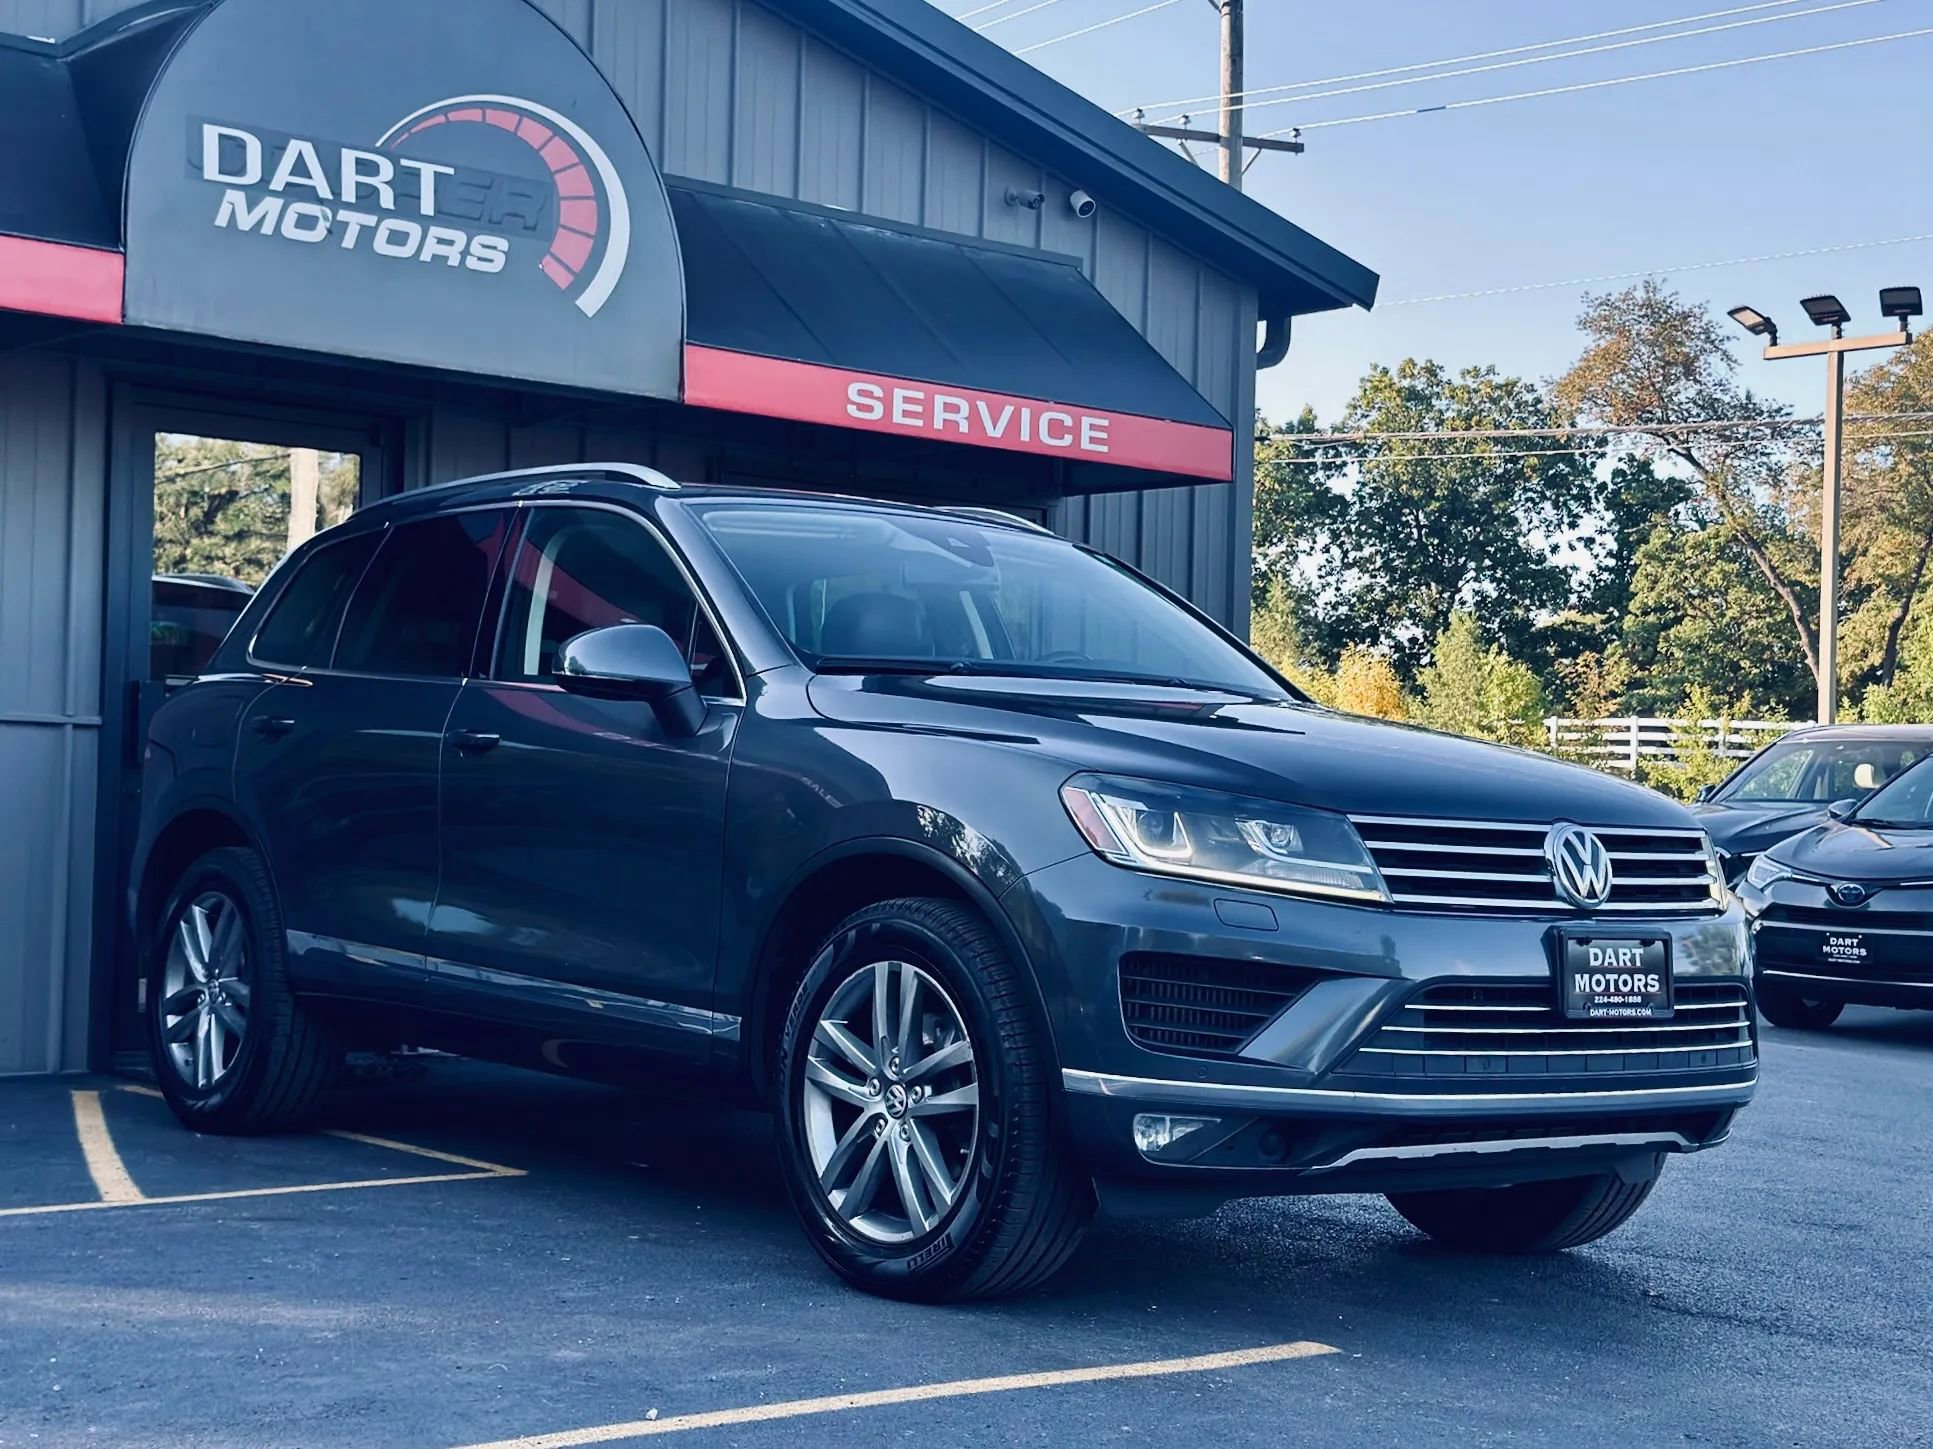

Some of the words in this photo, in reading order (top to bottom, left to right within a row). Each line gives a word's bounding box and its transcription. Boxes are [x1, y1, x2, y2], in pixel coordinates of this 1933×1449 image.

[202, 123, 455, 217] DART
[213, 188, 510, 274] MOTORS
[846, 382, 1110, 453] SERVICE
[1822, 945, 1867, 957] MOTORS
[1829, 937, 1859, 947] DART
[1588, 947, 1645, 968] DART
[1574, 973, 1661, 993] MOTORS
[906, 1231, 956, 1271] PIRELLI
